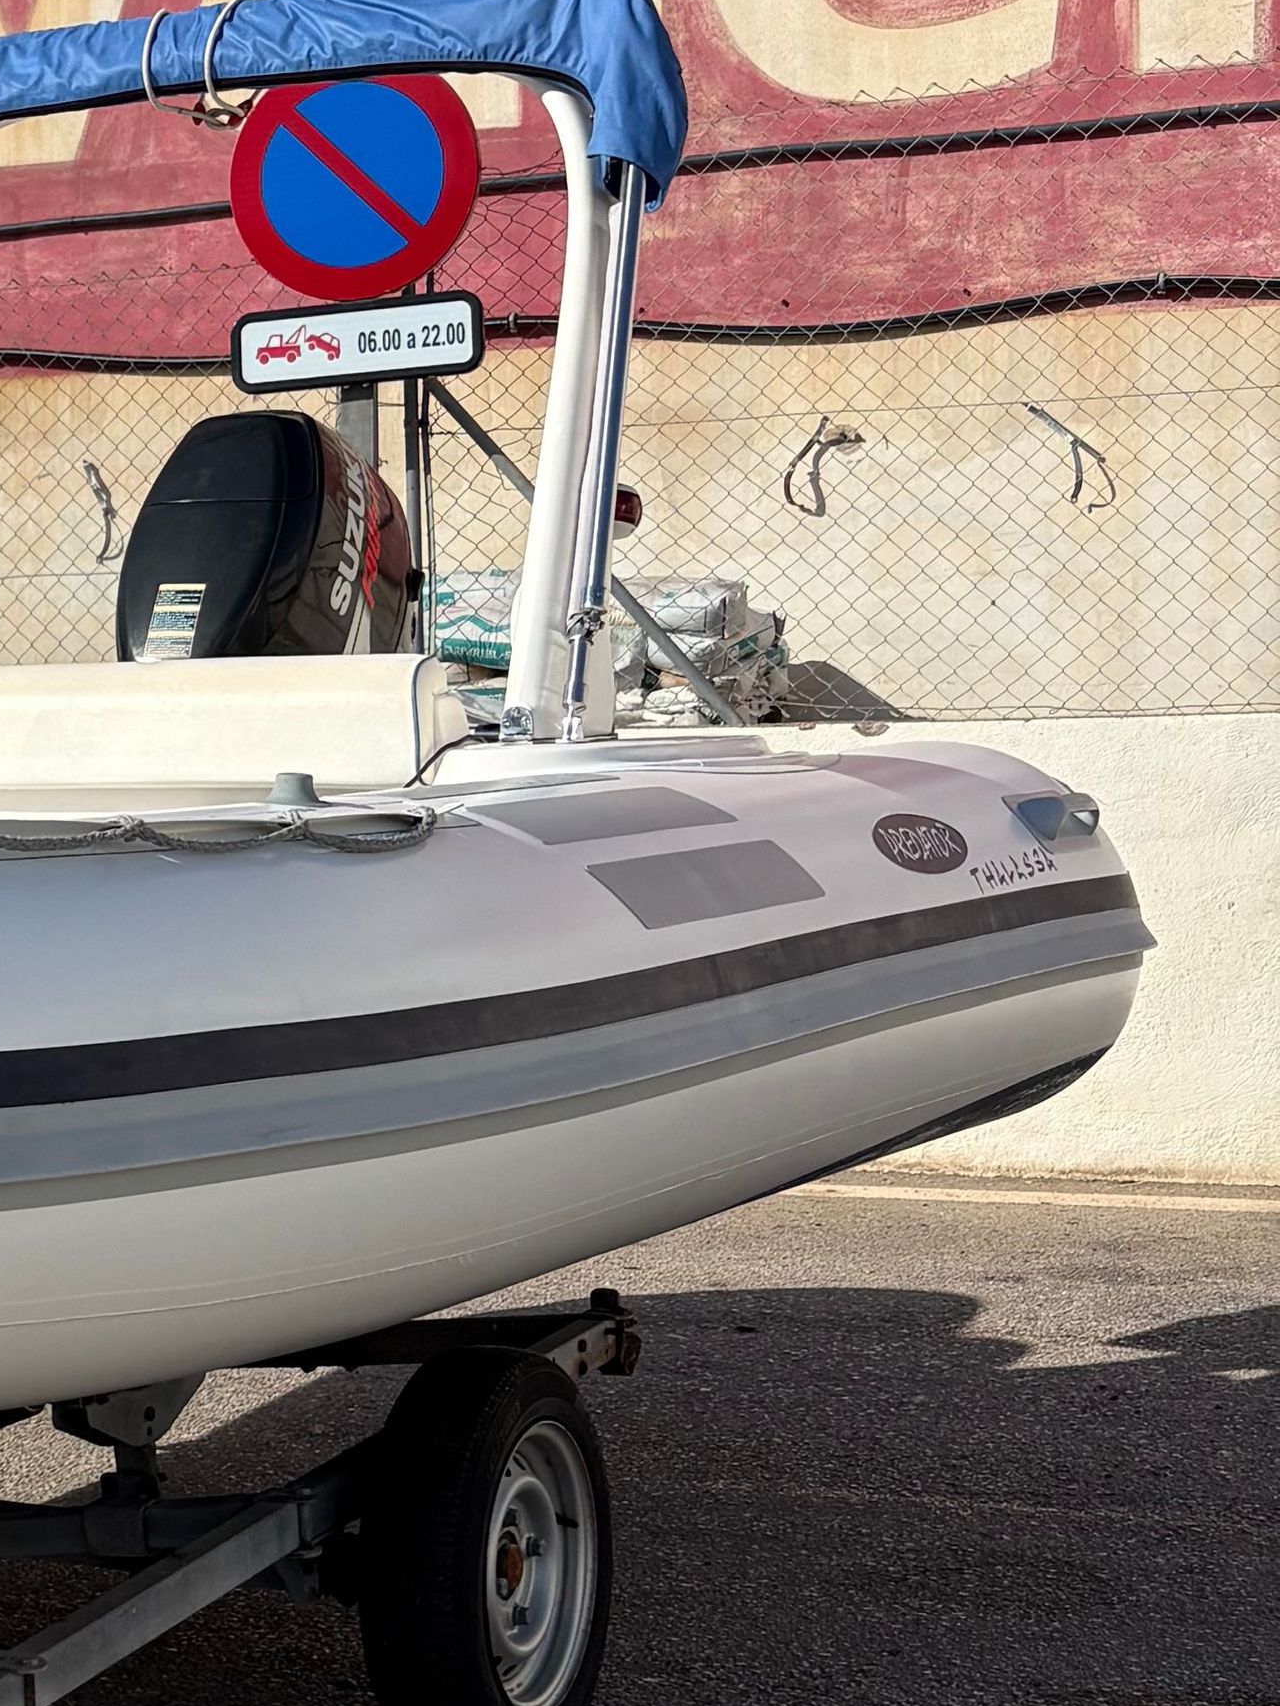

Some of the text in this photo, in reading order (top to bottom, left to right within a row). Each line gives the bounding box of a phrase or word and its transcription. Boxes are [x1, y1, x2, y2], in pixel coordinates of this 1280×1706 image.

[358, 321, 465, 354] 06.00 a 22.00
[877, 821, 963, 863] PREDATOR
